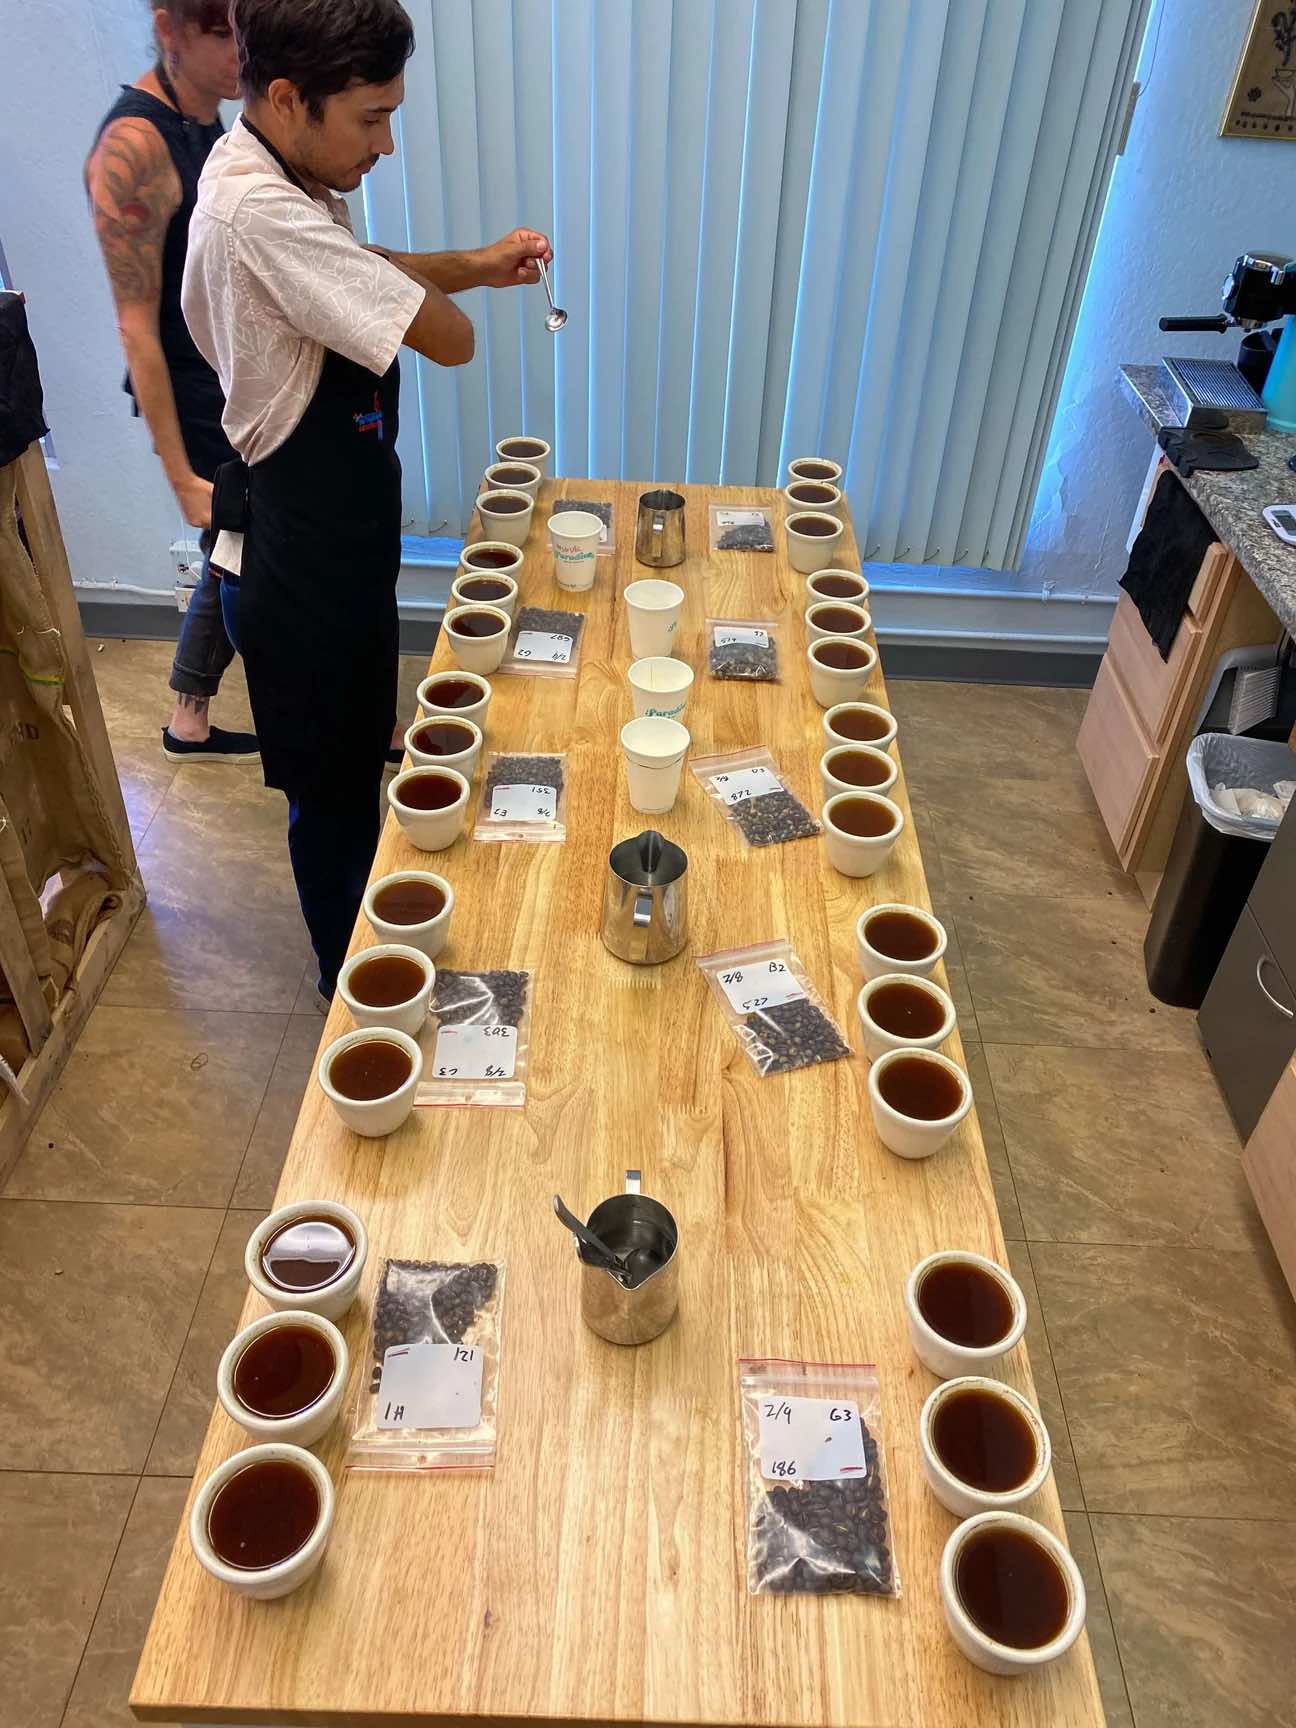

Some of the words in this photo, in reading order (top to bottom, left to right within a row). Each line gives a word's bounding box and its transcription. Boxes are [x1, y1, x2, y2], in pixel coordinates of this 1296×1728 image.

[731, 789, 752, 801] 872
[722, 971, 744, 984] 2/8
[769, 962, 786, 973] B2
[772, 1461, 797, 1477] 186
